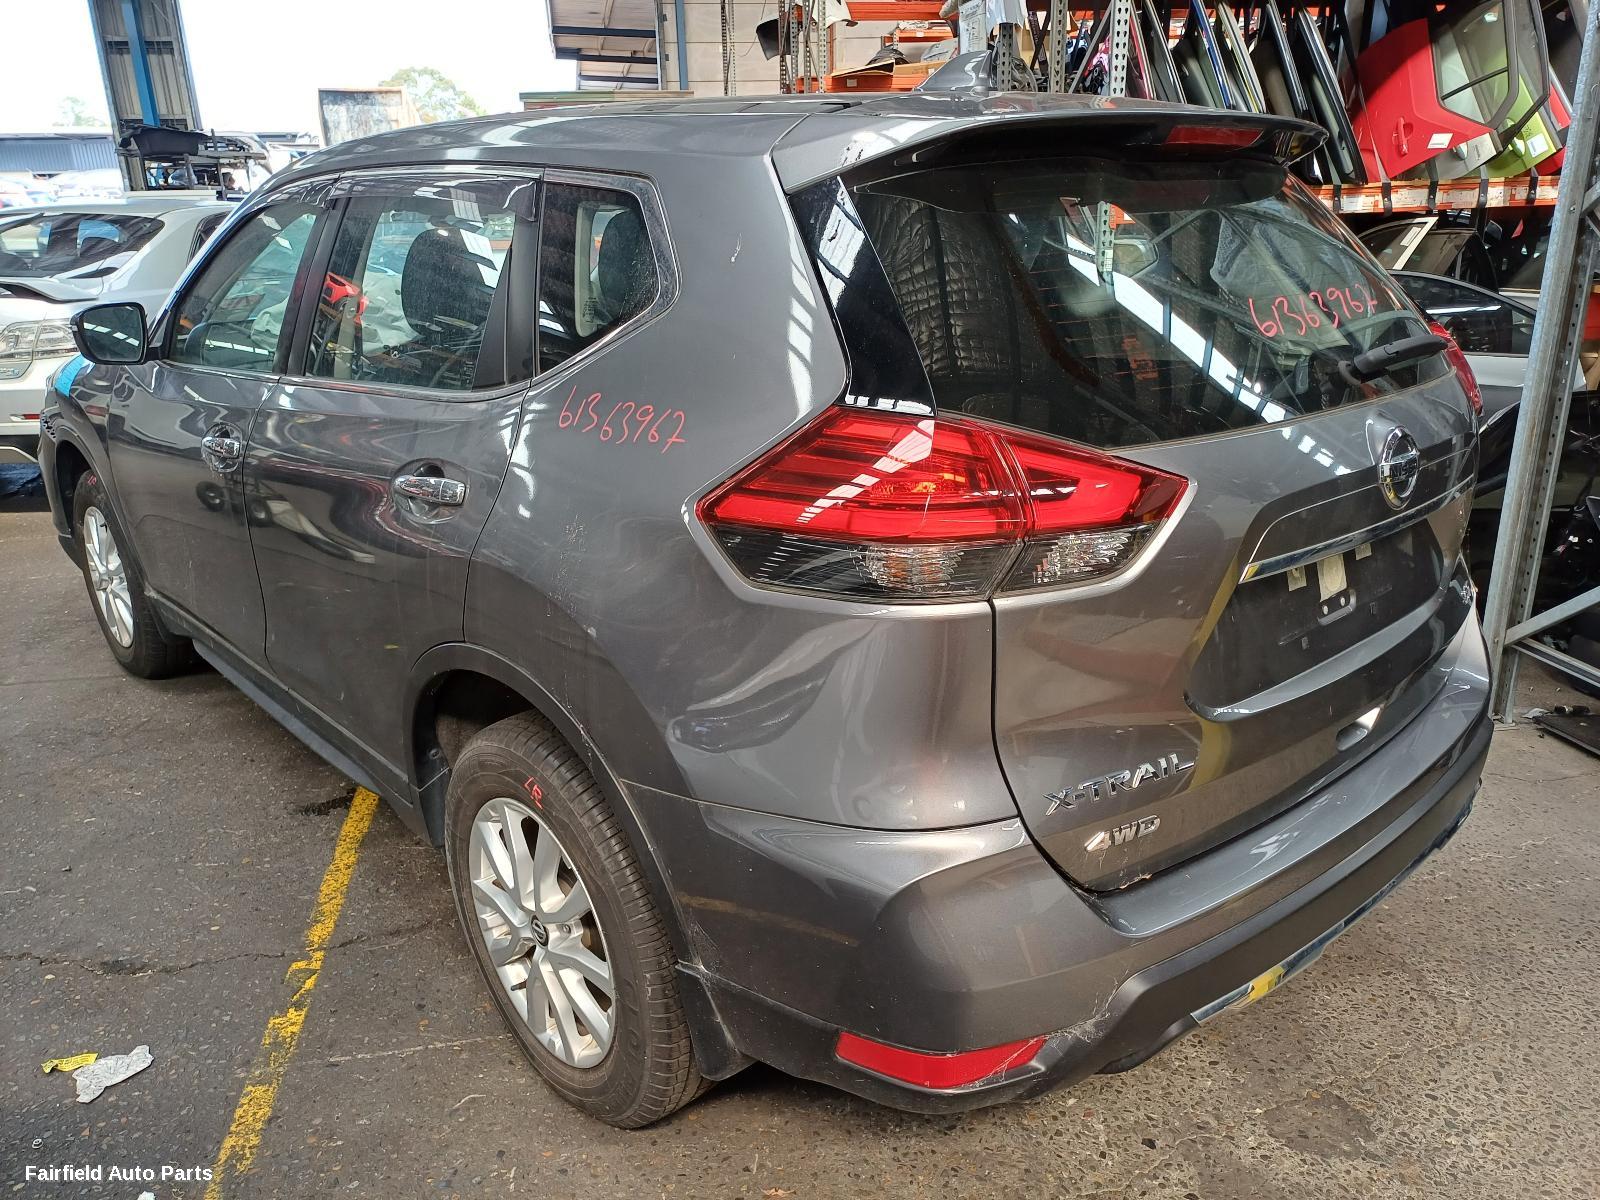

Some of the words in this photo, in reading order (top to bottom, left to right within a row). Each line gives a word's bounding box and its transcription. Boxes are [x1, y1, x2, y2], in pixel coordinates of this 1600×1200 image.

[558, 384, 687, 455] 61363967
[1042, 752, 1195, 816] X-TRAIL
[1083, 814, 1161, 852] 4WD
